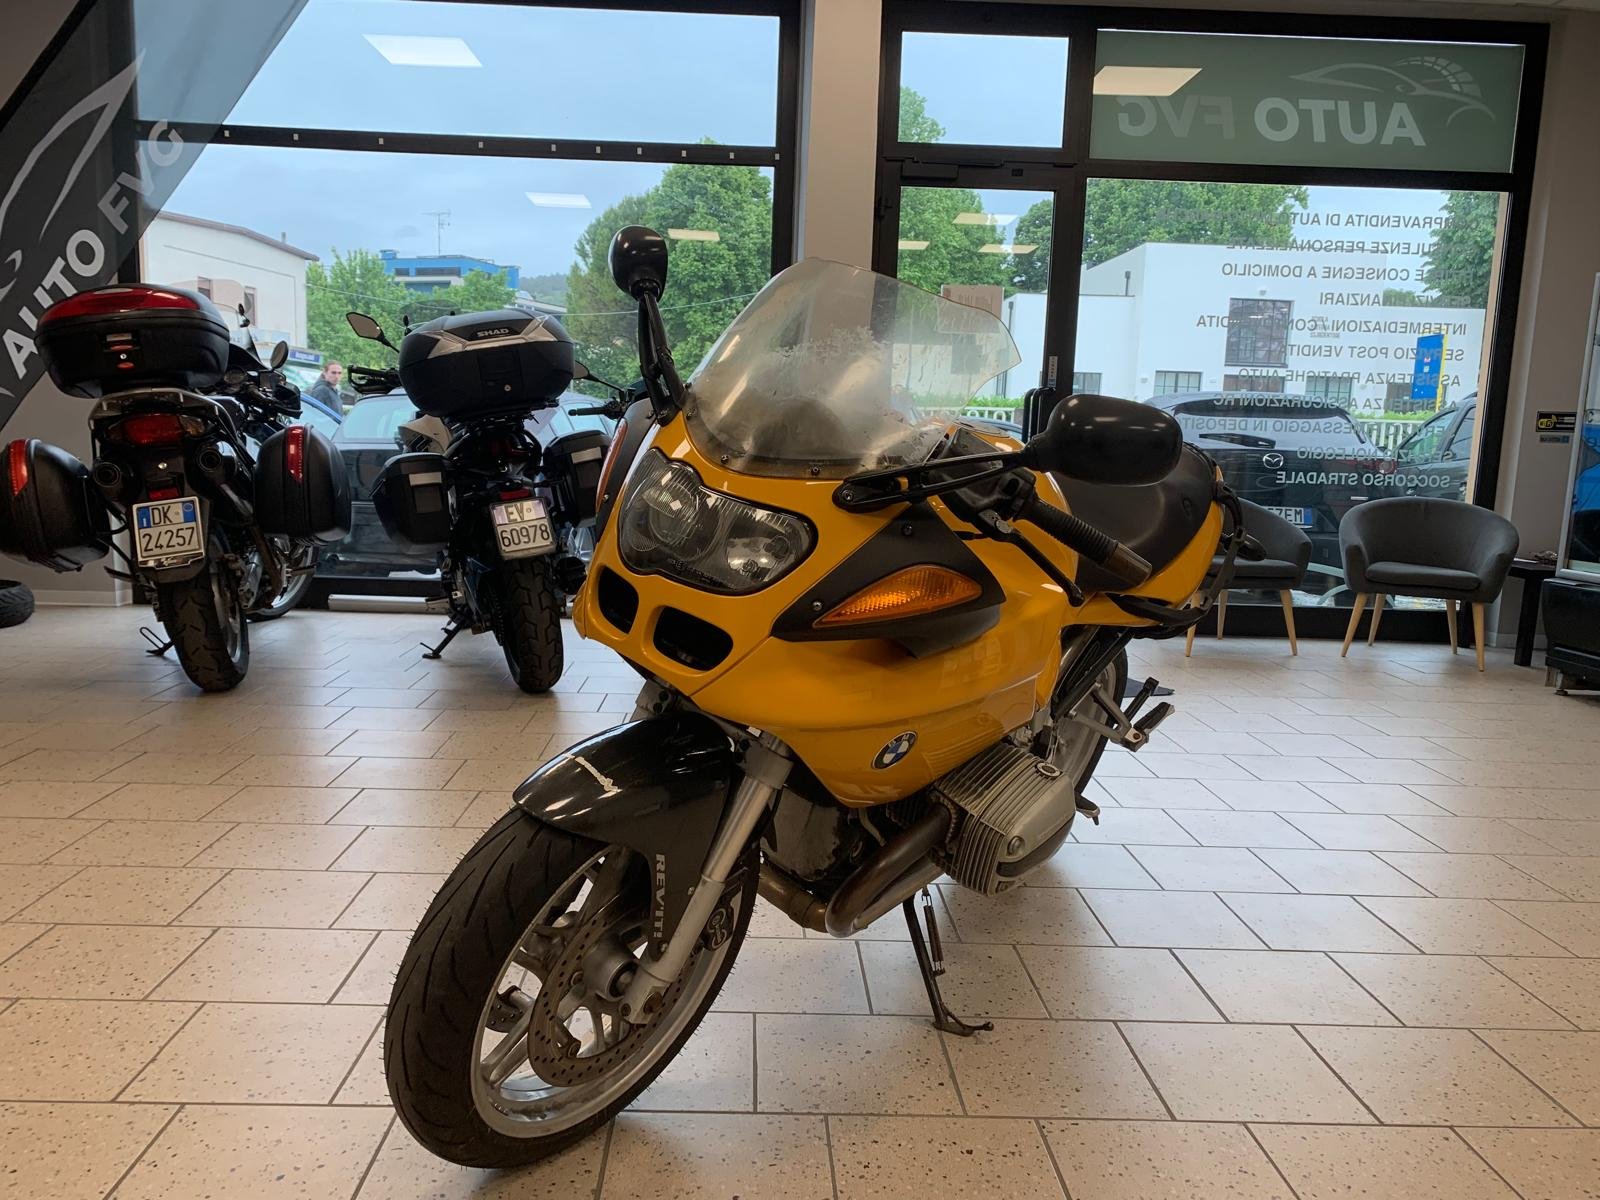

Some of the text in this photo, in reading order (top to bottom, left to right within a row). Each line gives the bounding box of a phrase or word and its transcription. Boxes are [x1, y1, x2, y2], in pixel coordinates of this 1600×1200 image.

[97, 119, 184, 235] FVG
[477, 328, 509, 338] SHAD
[151, 505, 173, 525] DK
[504, 502, 525, 523] EV
[1268, 507, 1303, 523] 7EM
[142, 526, 195, 552] 24257
[500, 523, 550, 547] 60978
